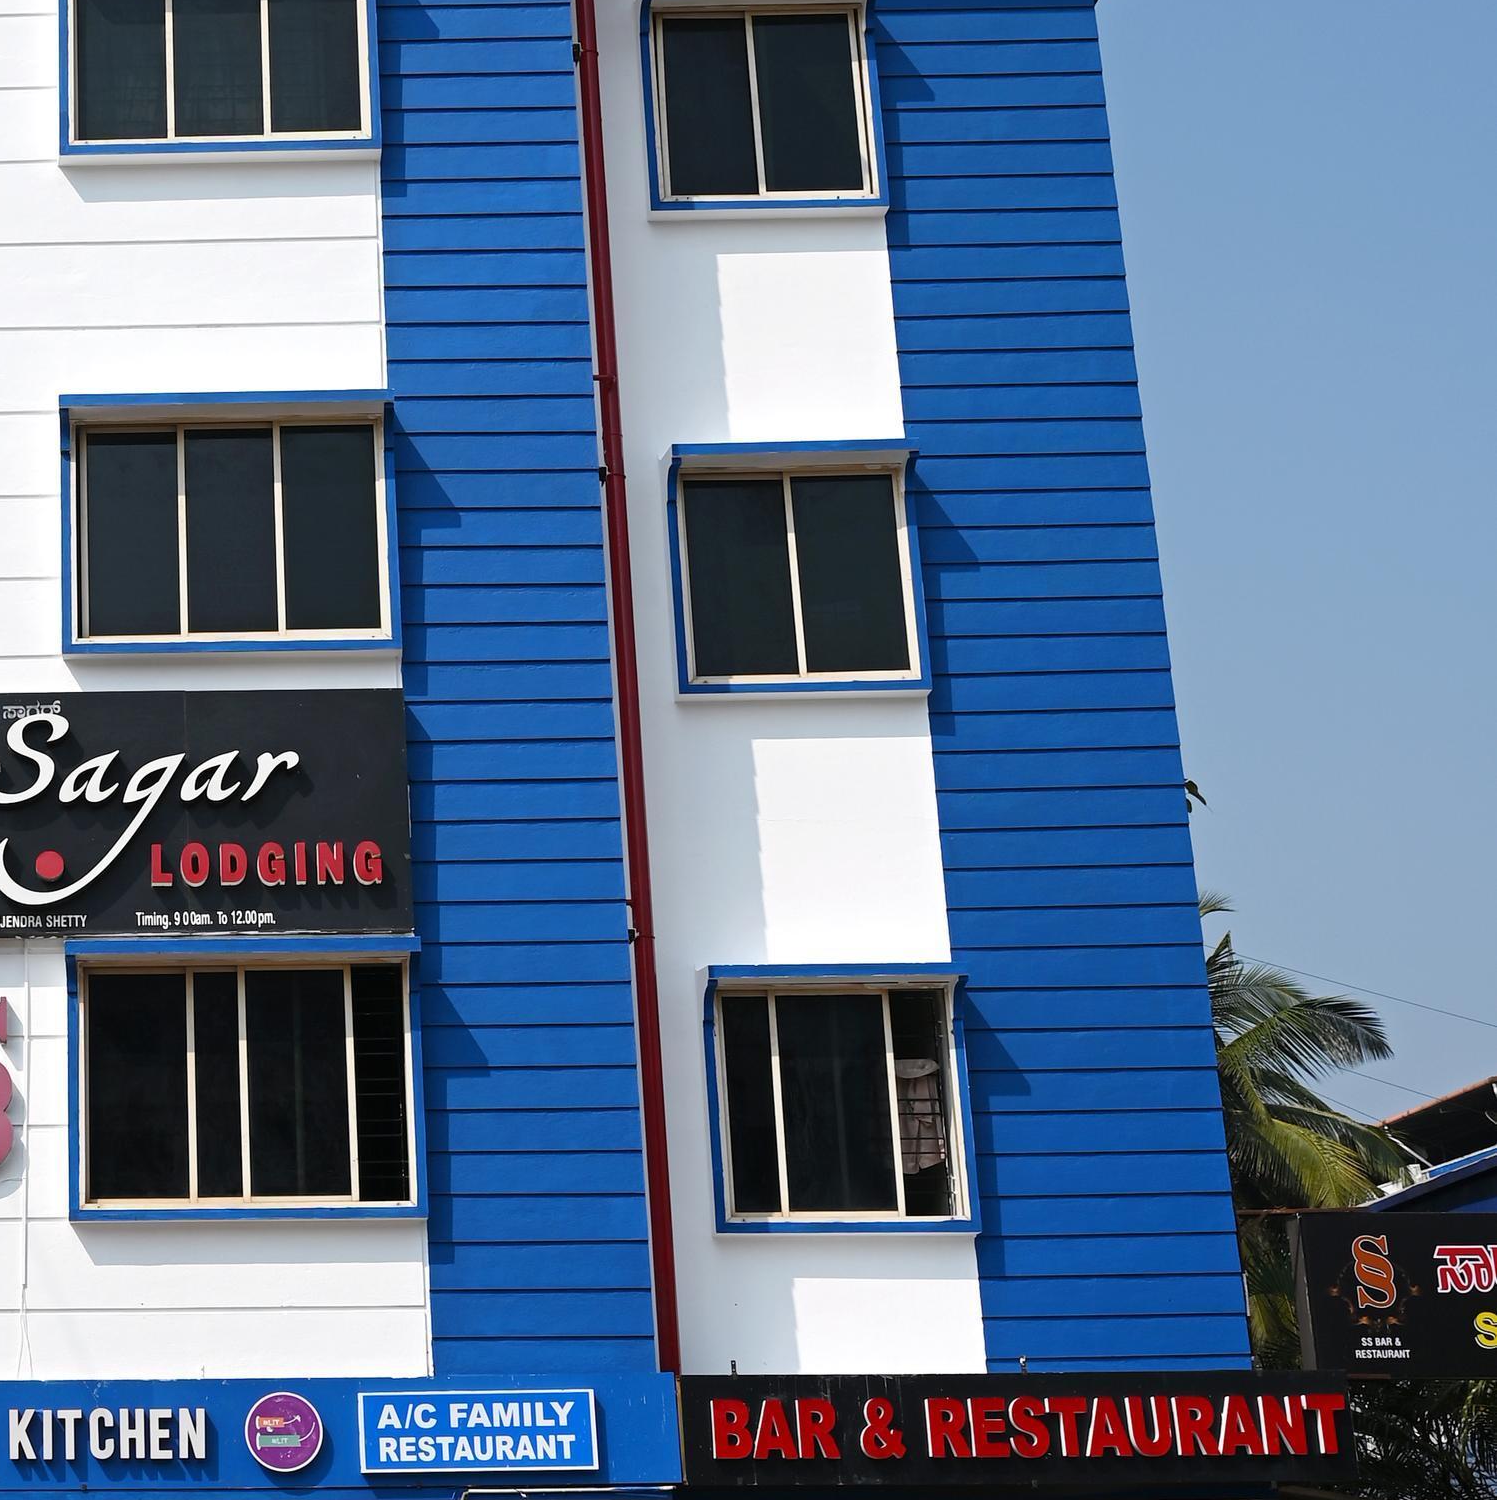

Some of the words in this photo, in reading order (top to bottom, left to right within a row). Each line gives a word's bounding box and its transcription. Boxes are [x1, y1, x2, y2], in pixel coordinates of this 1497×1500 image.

[149, 840, 383, 887] LODGING
[46, 914, 88, 928] SHETTY
[218, 911, 228, 925] To
[1355, 1349, 1411, 1359] RESTAURANT
[1361, 1338, 1373, 1347] SS
[1375, 1337, 1393, 1346] BAR
[1395, 1337, 1402, 1346] &
[377, 1402, 438, 1430] A/C
[449, 1401, 576, 1428] FAMILY
[710, 1396, 841, 1461] BAR
[858, 1397, 907, 1460] &
[923, 1393, 1346, 1460] RESTAURANT
[8, 1406, 207, 1461] KITCHEN
[378, 1434, 576, 1463] RESTAURANT
